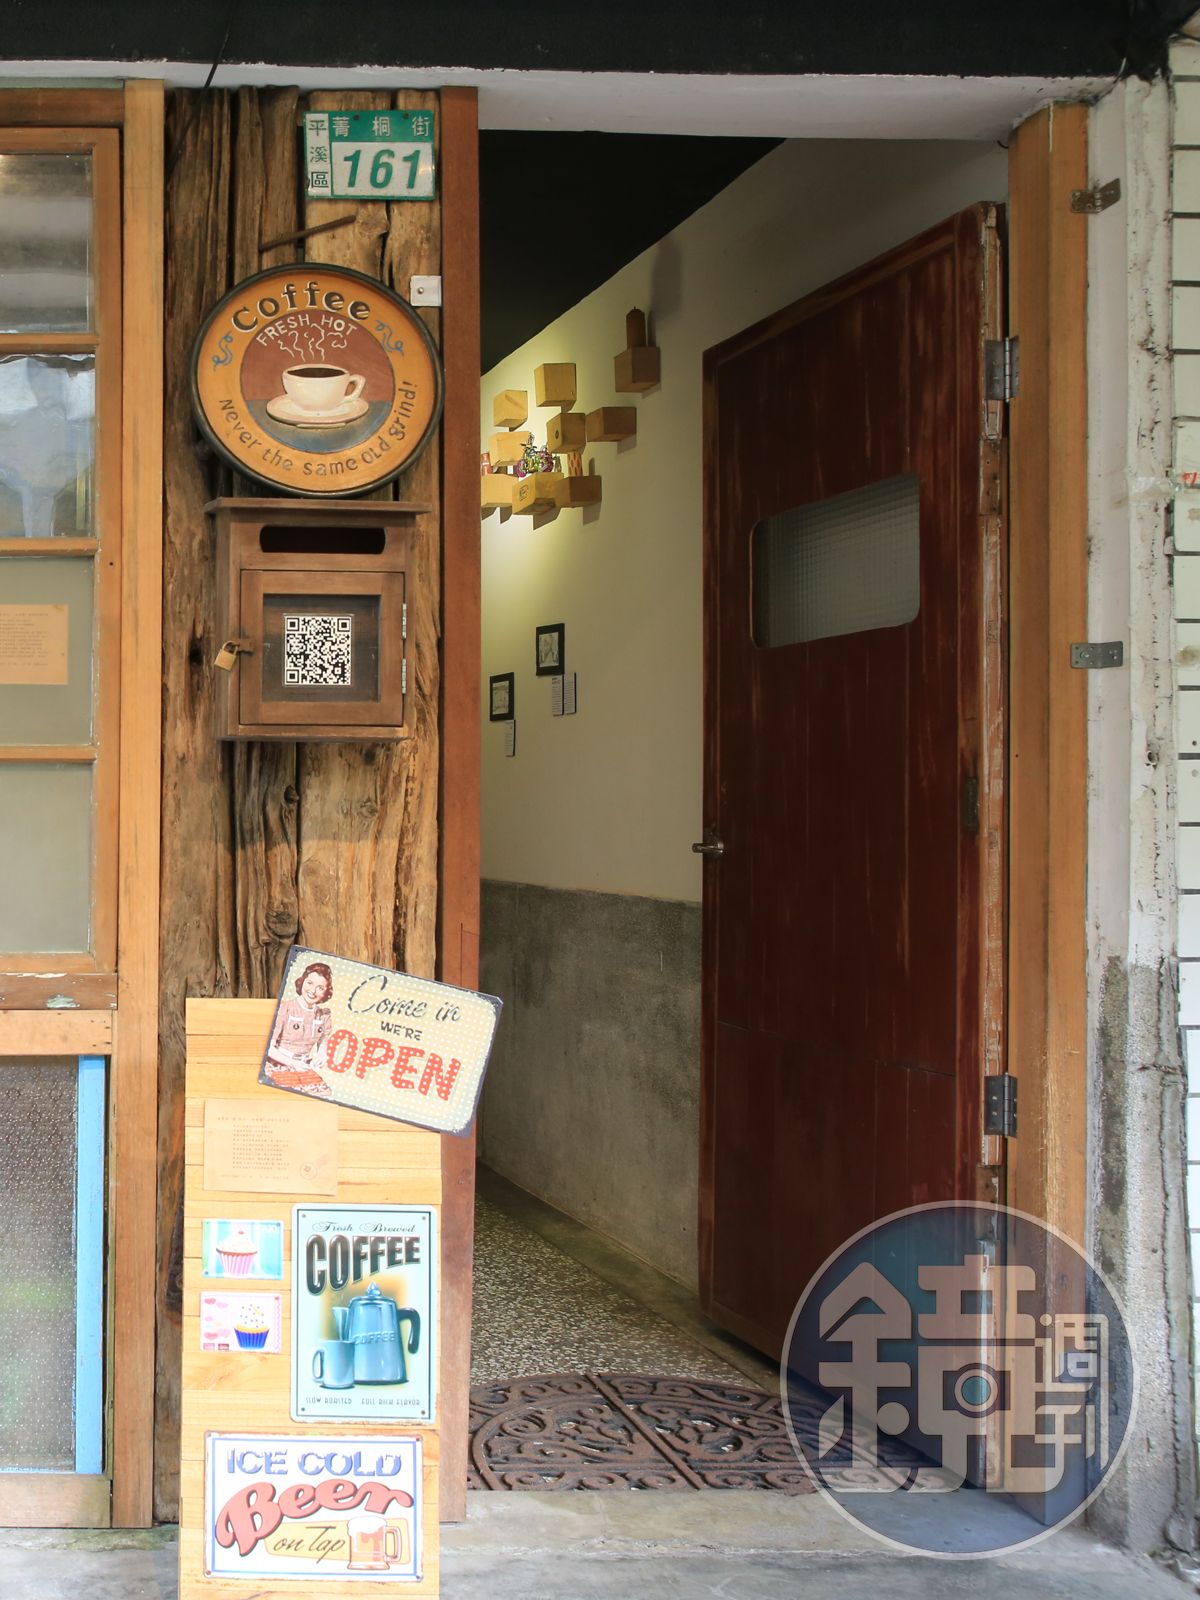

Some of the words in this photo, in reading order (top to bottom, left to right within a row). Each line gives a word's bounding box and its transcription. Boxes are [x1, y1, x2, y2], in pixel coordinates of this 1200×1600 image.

[332, 115, 430, 137] 菁桐街
[308, 119, 329, 188] 平溪區
[343, 149, 421, 189] 161
[231, 281, 371, 333] Coffee
[256, 314, 310, 346] FRESH
[320, 315, 357, 336] HOT
[219, 398, 262, 449] Never
[262, 447, 293, 472] the
[303, 457, 359, 477] same
[389, 380, 418, 441] grind!
[347, 974, 428, 1018] Come
[435, 1001, 461, 1022] in
[380, 1021, 422, 1041] WE'RE
[327, 1029, 461, 1101] OPEN
[312, 1221, 353, 1232] Fresh
[359, 1222, 416, 1233] Brewed
[306, 1233, 420, 1296] COFFEE
[353, 1330, 397, 1345] COFFEE
[226, 1447, 288, 1475] ICE
[297, 1450, 402, 1476] COLD
[215, 1478, 414, 1557] Beer
[273, 1537, 304, 1552] on
[305, 1525, 346, 1564] Tap
